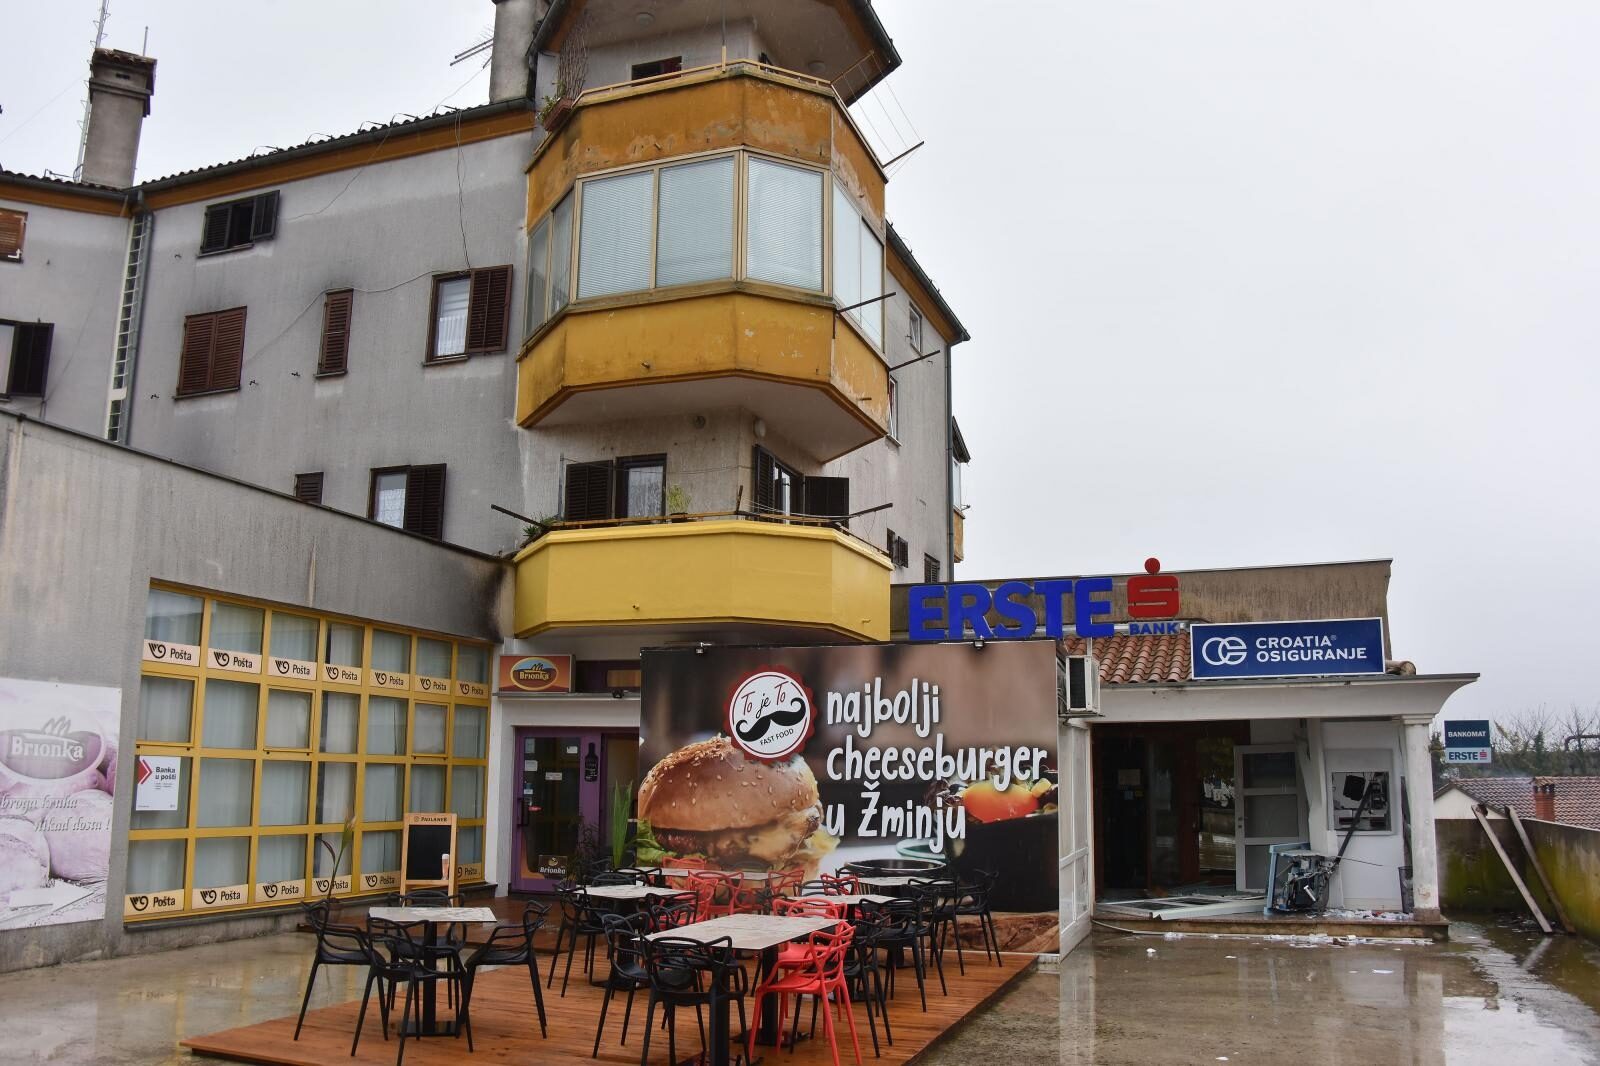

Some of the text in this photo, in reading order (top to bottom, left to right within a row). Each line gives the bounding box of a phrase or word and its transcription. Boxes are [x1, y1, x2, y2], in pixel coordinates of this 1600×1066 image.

[908, 577, 1115, 640] ERSTE
[1129, 622, 1180, 636] BANK
[170, 648, 192, 661] Pošta
[1255, 647, 1367, 662] OSIGURANJE
[233, 657, 253, 669] Pošta
[292, 664, 311, 675] Pošta
[341, 670, 358, 681] Pošta
[389, 675, 404, 686] Pošta
[519, 671, 550, 681] Brionka
[433, 681, 447, 691] Pošta
[471, 686, 484, 696] Pošta
[741, 690, 756, 716] To
[774, 680, 789, 706] To
[827, 677, 940, 738] najbolji
[760, 728, 794, 745] FAST FOOD
[11, 735, 84, 762] Brionka
[1448, 751, 1479, 760] ERSTE
[826, 733, 1048, 792] cheeseburger
[160, 773, 177, 781] pošti
[825, 780, 966, 853] u Žminju
[332, 880, 349, 890] Pošta
[380, 875, 396, 885] Pošta
[281, 884, 299, 895] Pošta
[220, 890, 241, 901] Pošta
[152, 896, 176, 908] Pošta
